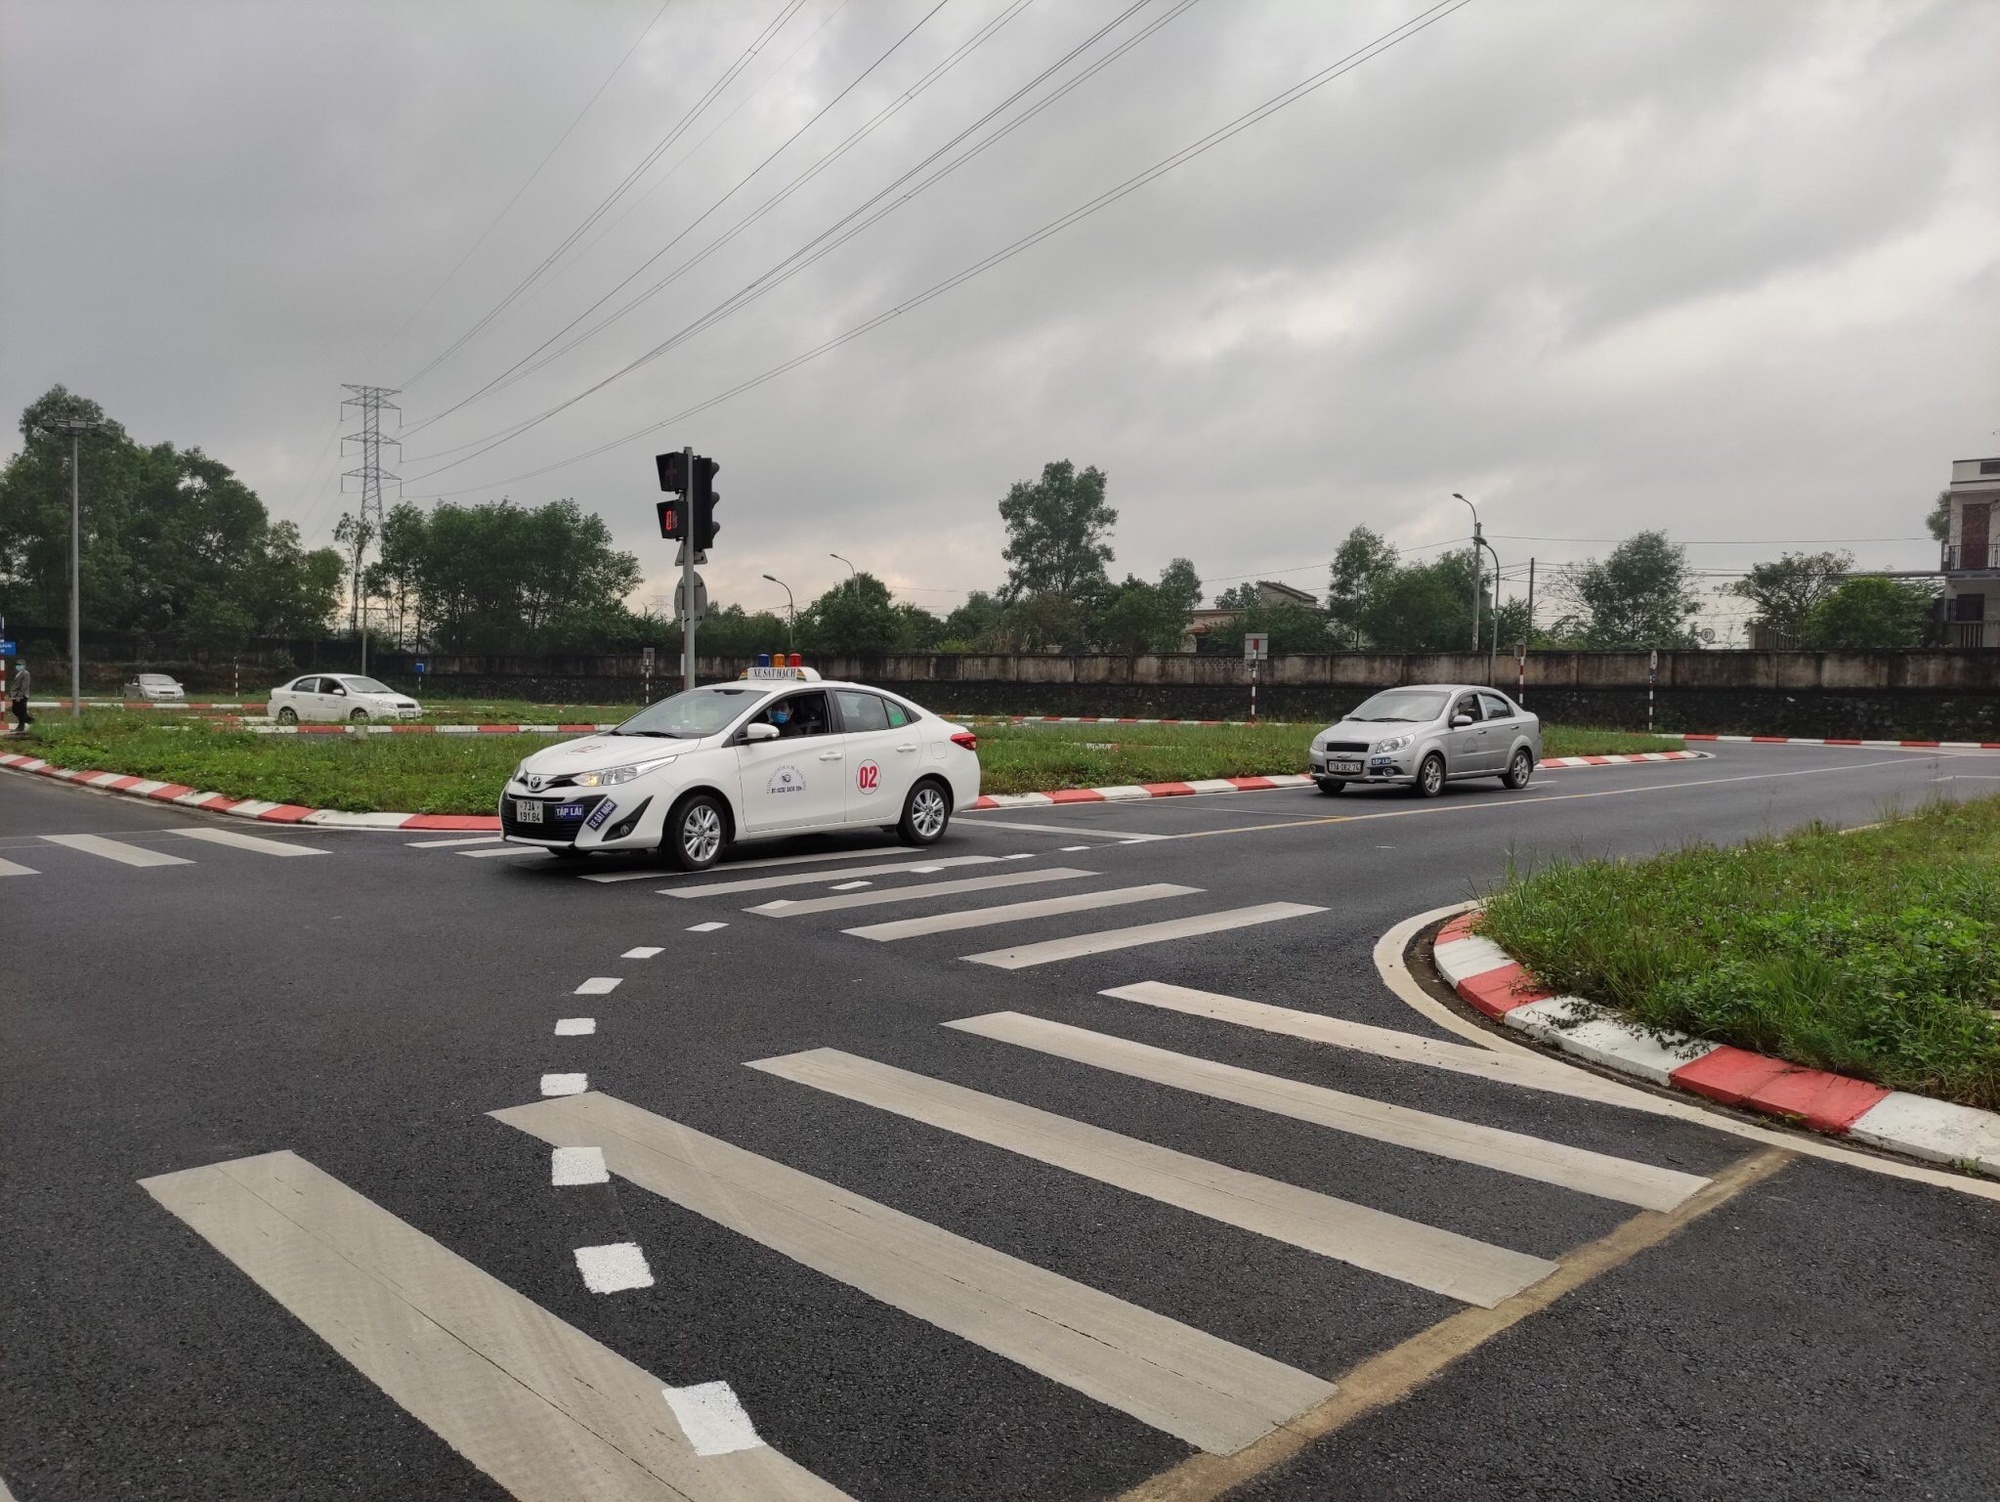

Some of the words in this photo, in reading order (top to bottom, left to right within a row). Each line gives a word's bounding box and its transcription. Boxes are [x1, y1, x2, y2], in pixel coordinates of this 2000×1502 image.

[753, 668, 763, 678] XE
[859, 765, 877, 789] 02
[523, 801, 536, 811] 73A
[589, 819, 599, 829] XE
